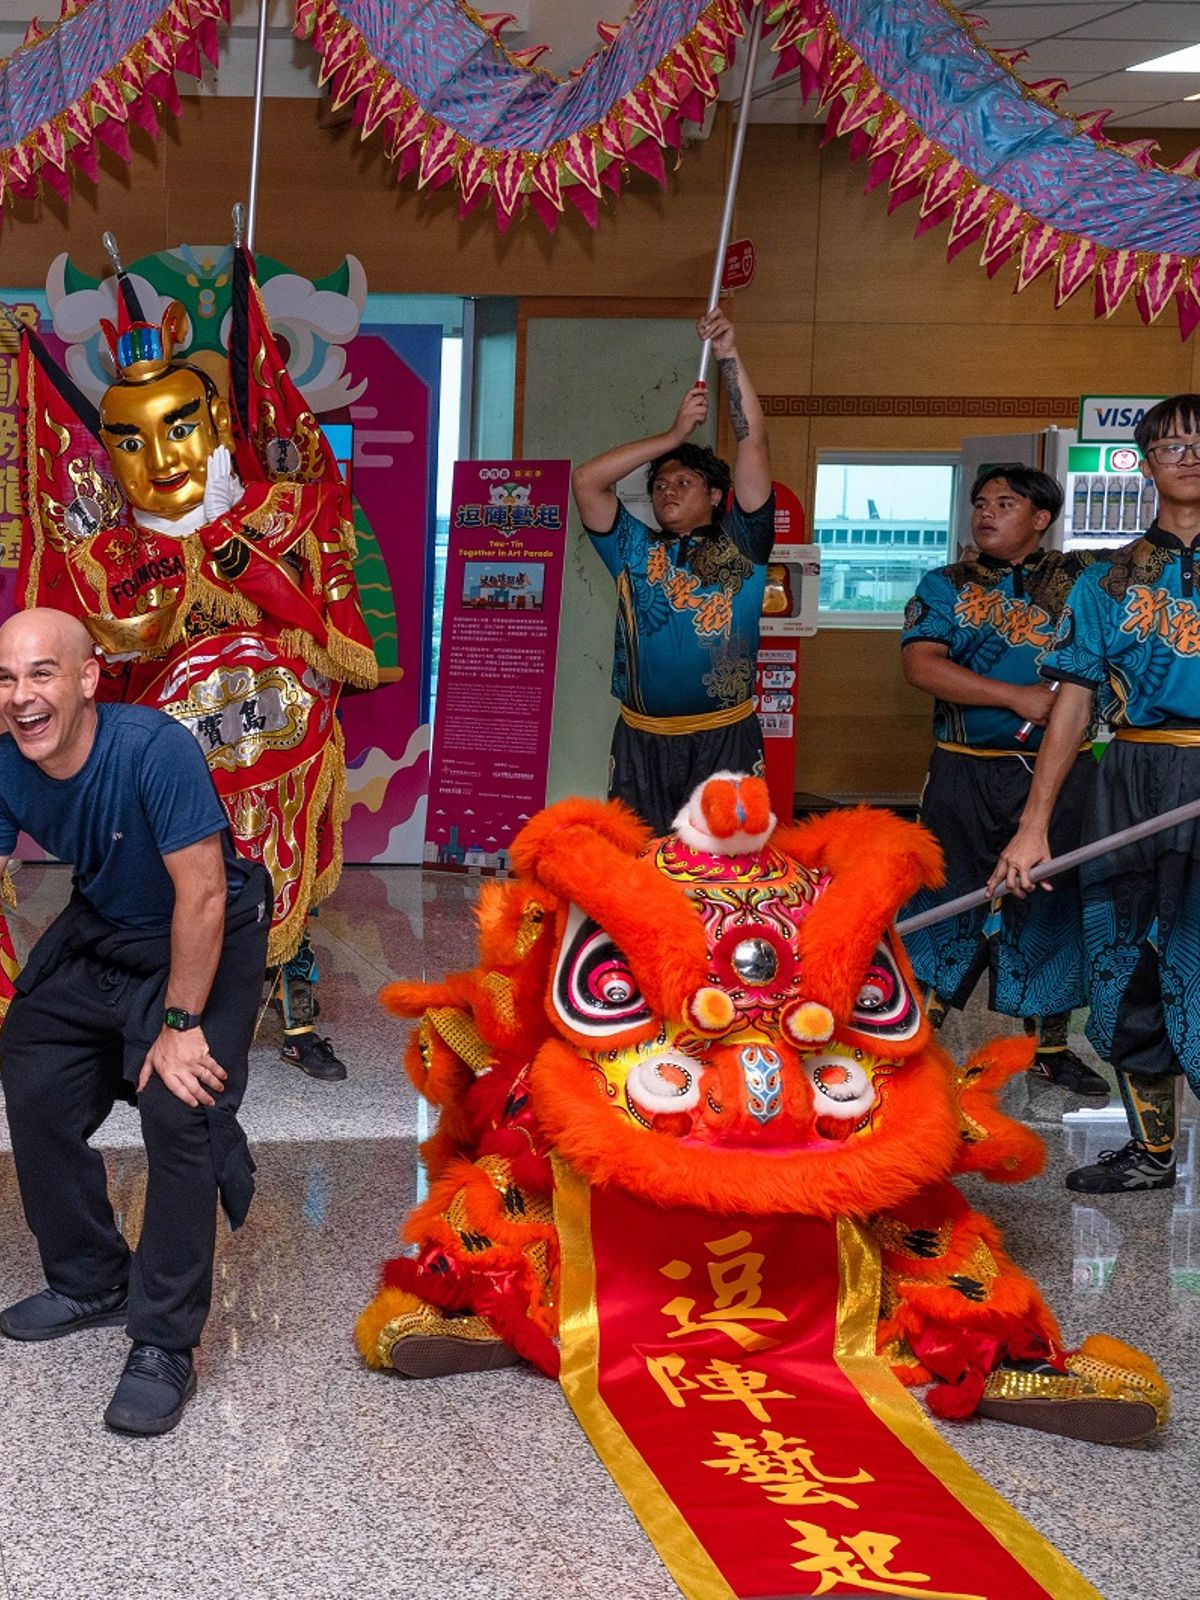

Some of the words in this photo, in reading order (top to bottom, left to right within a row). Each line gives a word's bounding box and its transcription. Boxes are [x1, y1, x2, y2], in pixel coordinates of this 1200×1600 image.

[1094, 408, 1146, 427] VISA
[455, 503, 562, 531] 逗陣藝起
[458, 549, 496, 558] Together
[498, 549, 507, 557] in
[507, 549, 522, 557] Art
[523, 549, 554, 558] Parade
[646, 1230, 987, 1600] 逗陣藝起
